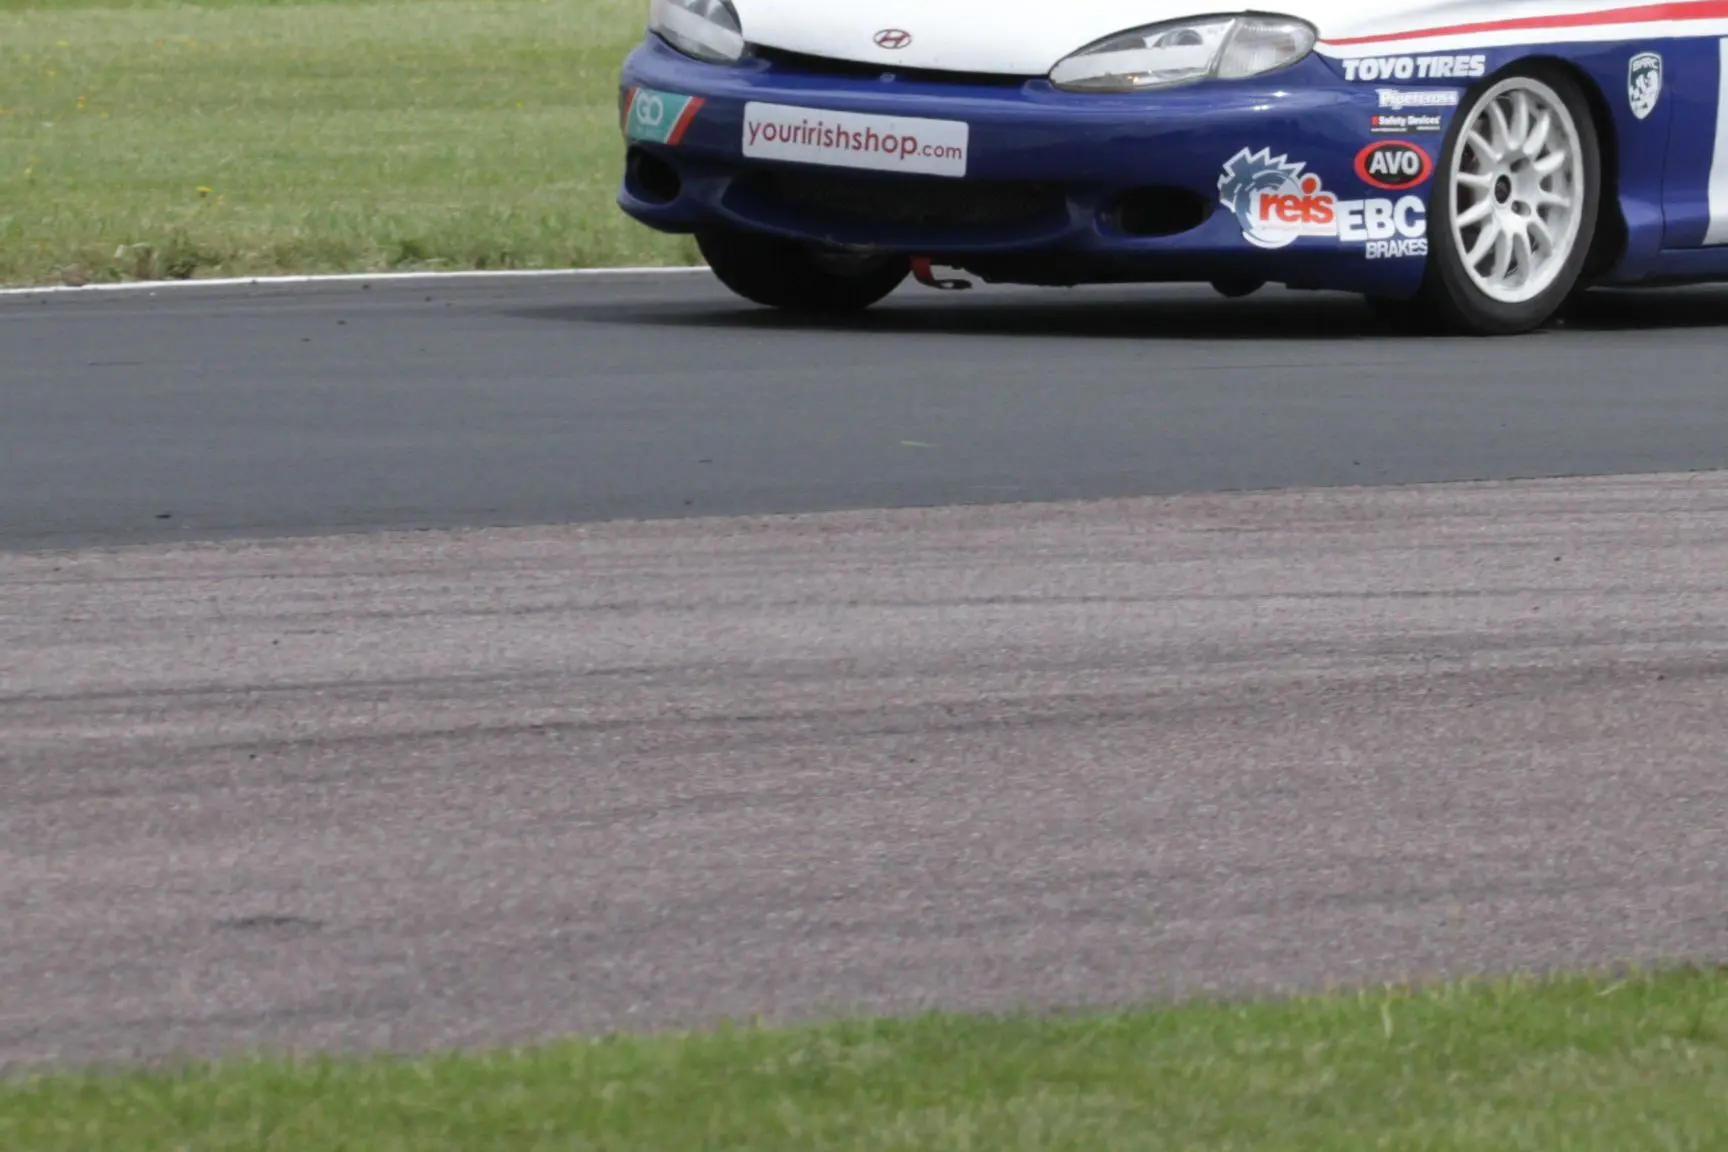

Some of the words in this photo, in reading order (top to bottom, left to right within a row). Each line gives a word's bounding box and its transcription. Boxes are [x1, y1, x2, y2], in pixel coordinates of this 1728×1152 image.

[1342, 56, 1416, 81] TOYO
[1417, 54, 1486, 78] TIRES
[748, 119, 963, 160] youririshshop.com
[1369, 151, 1420, 175] AVO
[1259, 176, 1335, 224] reis
[1337, 196, 1427, 242] EBC
[1365, 238, 1429, 260] BRAKES
